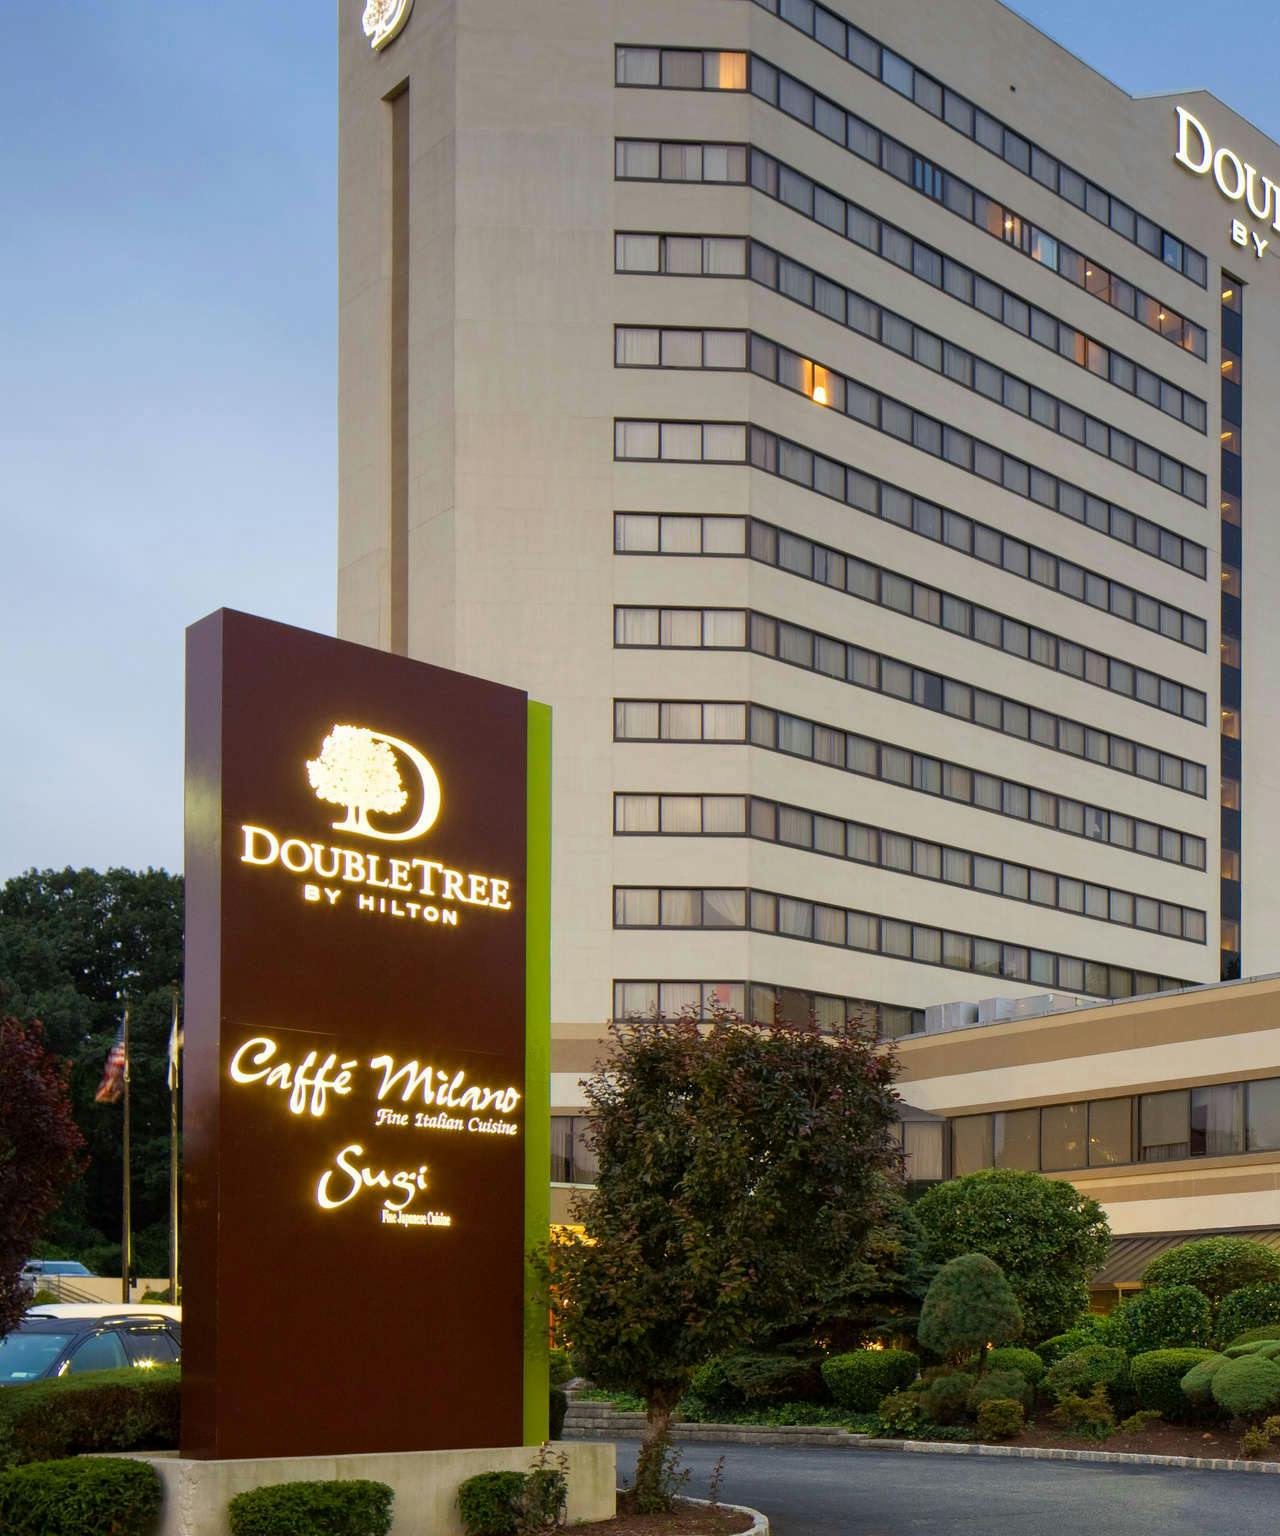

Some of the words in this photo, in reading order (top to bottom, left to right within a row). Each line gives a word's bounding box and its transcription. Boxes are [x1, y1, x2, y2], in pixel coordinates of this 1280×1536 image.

[1231, 218, 1268, 258] BY
[240, 824, 512, 911] DOUBLETREE
[304, 884, 342, 905] BY
[358, 894, 458, 926] HILTON
[230, 1037, 358, 1117] Caffé
[370, 1055, 521, 1113] Milano
[375, 1108, 409, 1126] Fine
[414, 1112, 464, 1131] Italian
[467, 1117, 518, 1136] Cuisine
[317, 1144, 428, 1211] Sugi
[382, 1209, 397, 1224] Fine
[397, 1210, 427, 1227] Japanese
[427, 1211, 451, 1226] Cuisine
